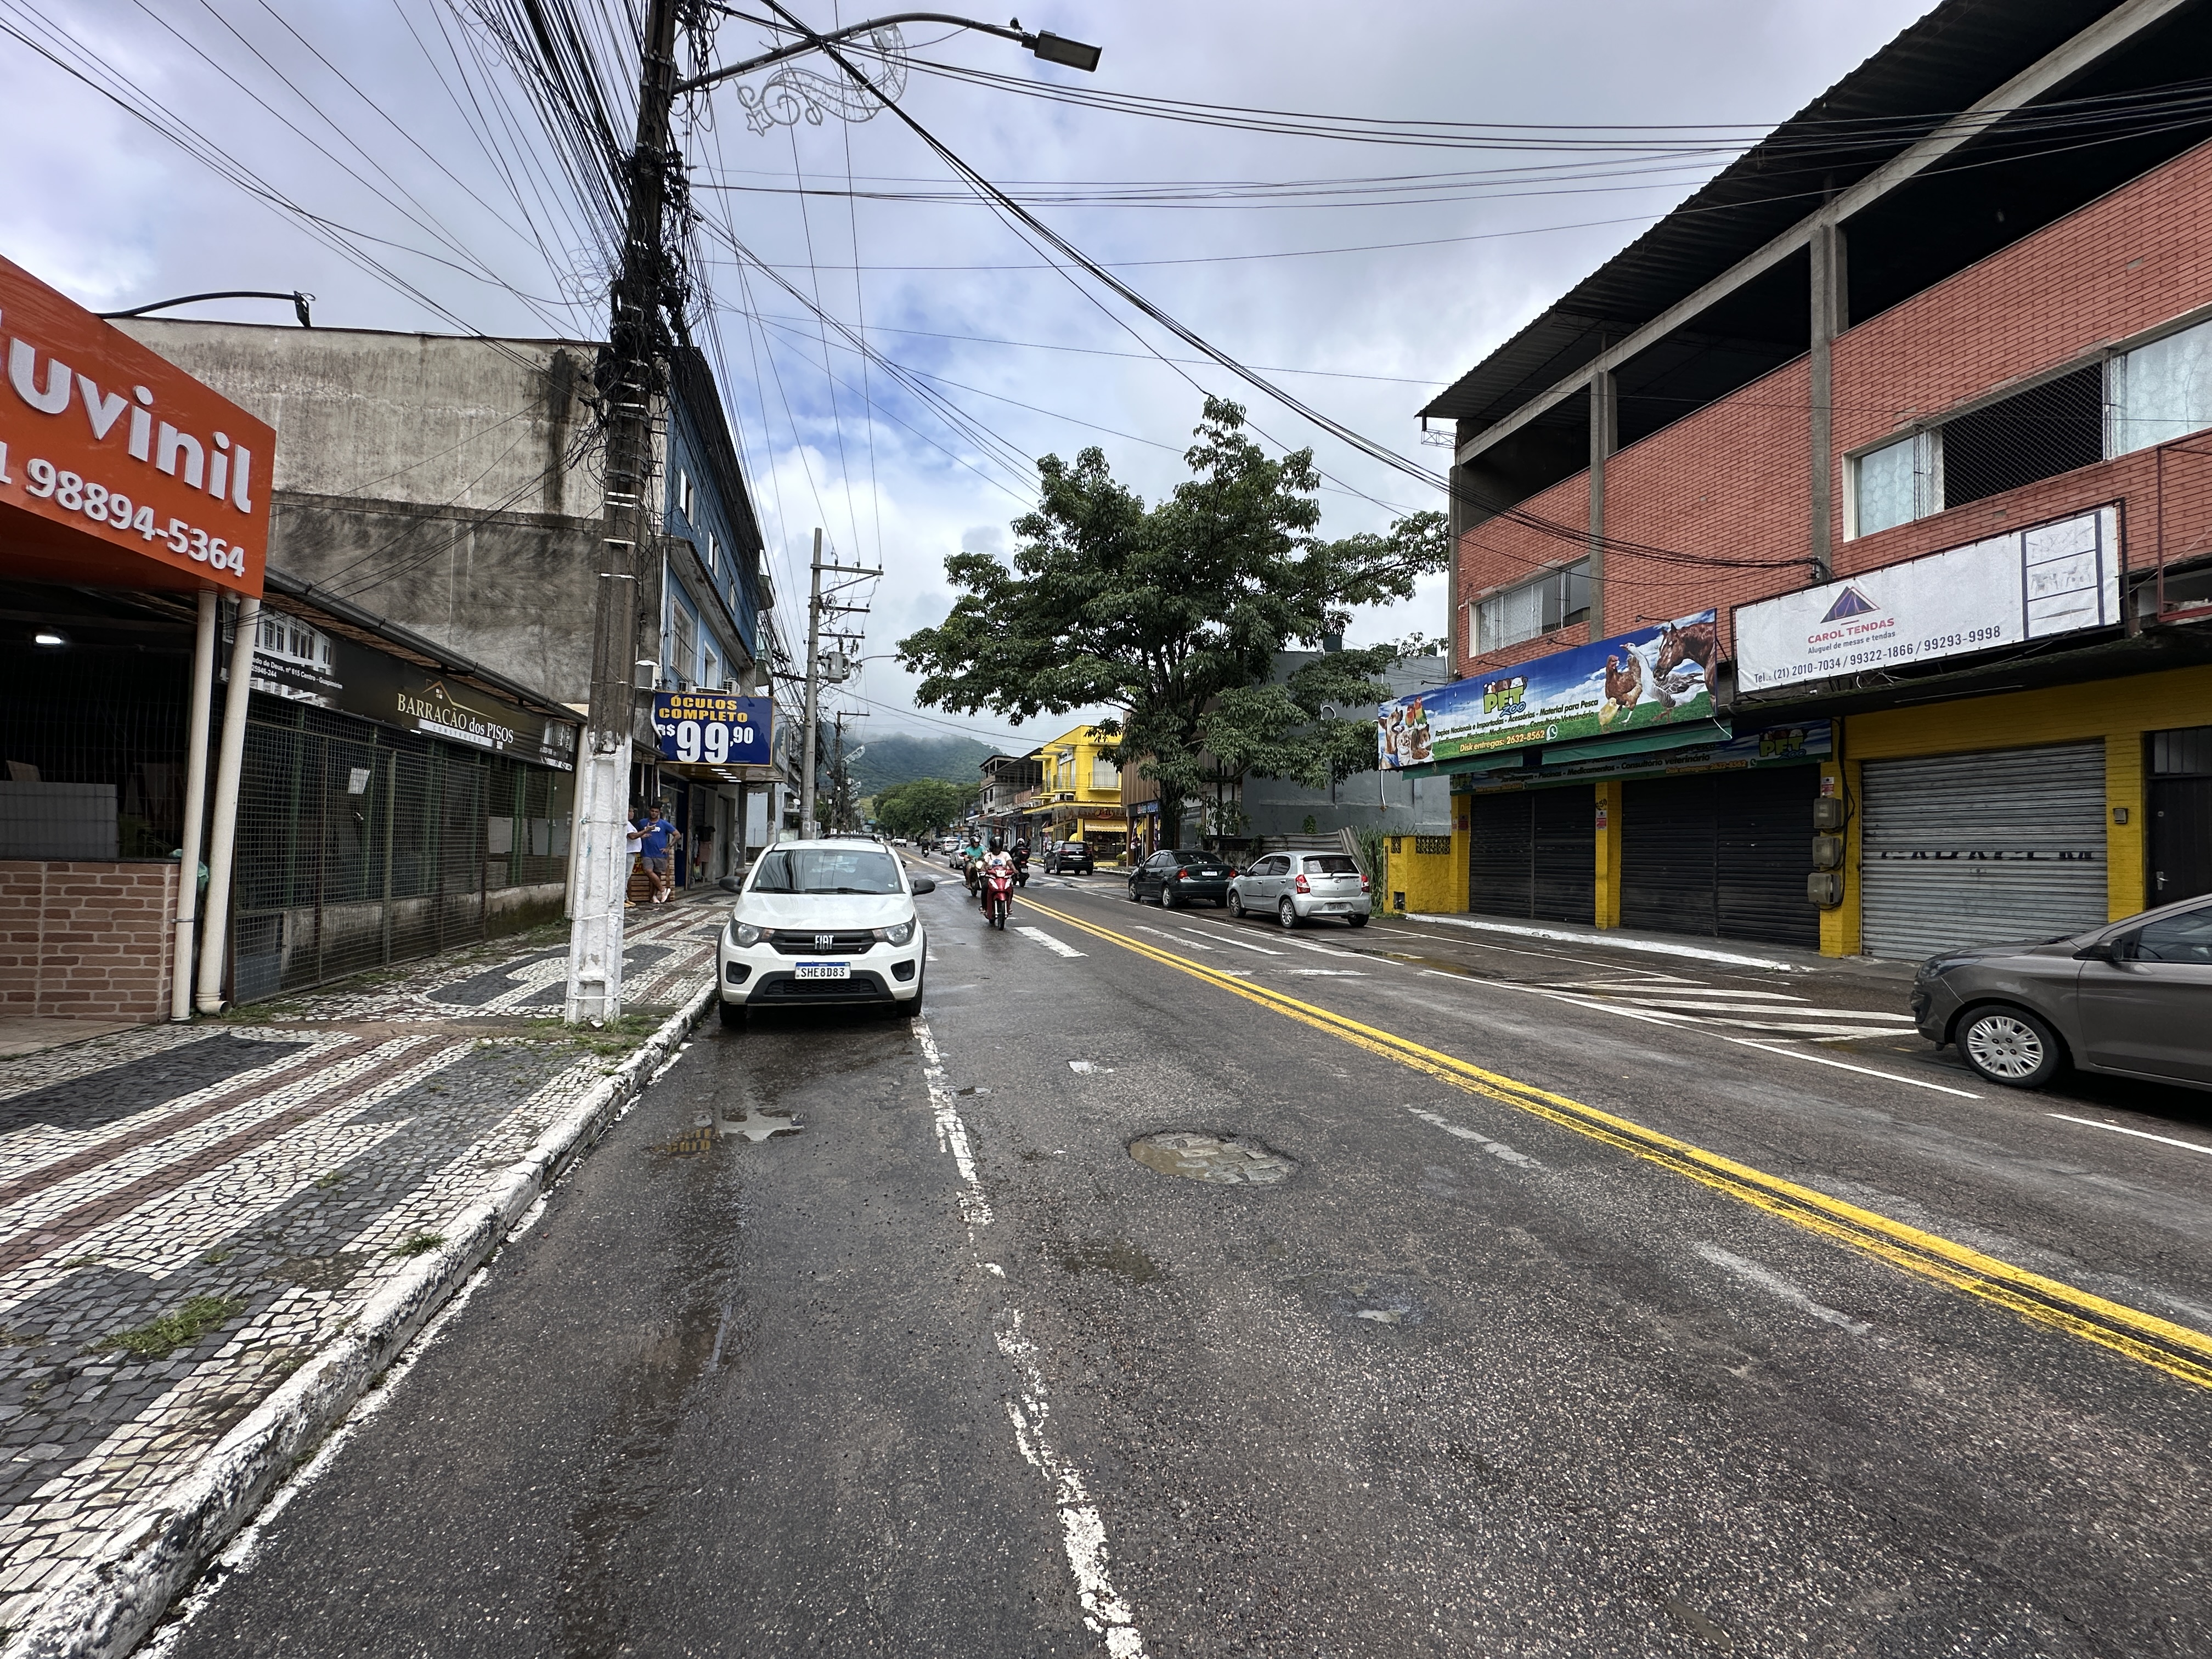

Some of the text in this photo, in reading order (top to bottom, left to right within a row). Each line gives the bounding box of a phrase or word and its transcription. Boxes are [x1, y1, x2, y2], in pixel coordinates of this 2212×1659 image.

[0, 321, 251, 514] uvinil
[26, 459, 245, 577] 98894-5364
[1808, 618, 1895, 644] CAROL TENDAS
[1808, 644, 1831, 654] Aluguel
[1843, 638, 1864, 647] mesas
[1872, 630, 1895, 641] tendas
[1774, 667, 1790, 680] (21)
[1792, 657, 1841, 676] 2010-7034
[1850, 644, 1913, 665] 99322-1866
[1924, 625, 2001, 651] 99293-9998
[670, 695, 737, 710] ÓCULOS
[1483, 685, 1524, 714] PET
[397, 693, 514, 743] BARRACÃO dos PISOS
[659, 708, 748, 723] COMPLETO
[1476, 718, 1504, 730] Importadas
[1508, 710, 1535, 723] Acessórios
[1539, 704, 1563, 716] Material
[1564, 702, 1579, 714] para
[1581, 699, 1599, 709] Pesca
[1489, 724, 1525, 736] Medicamentos
[1530, 716, 1560, 728] Consultório
[1561, 709, 1594, 723] Veterinário
[657, 724, 675, 737] R$
[1460, 730, 1545, 752] Disk entregas: 2632-8562
[1759, 736, 1804, 757] PET
[1567, 765, 1615, 776] Medicamentos
[1621, 759, 1663, 770] Consultório
[815, 935, 834, 950] FIAT
[800, 967, 845, 977] SHE8D83
